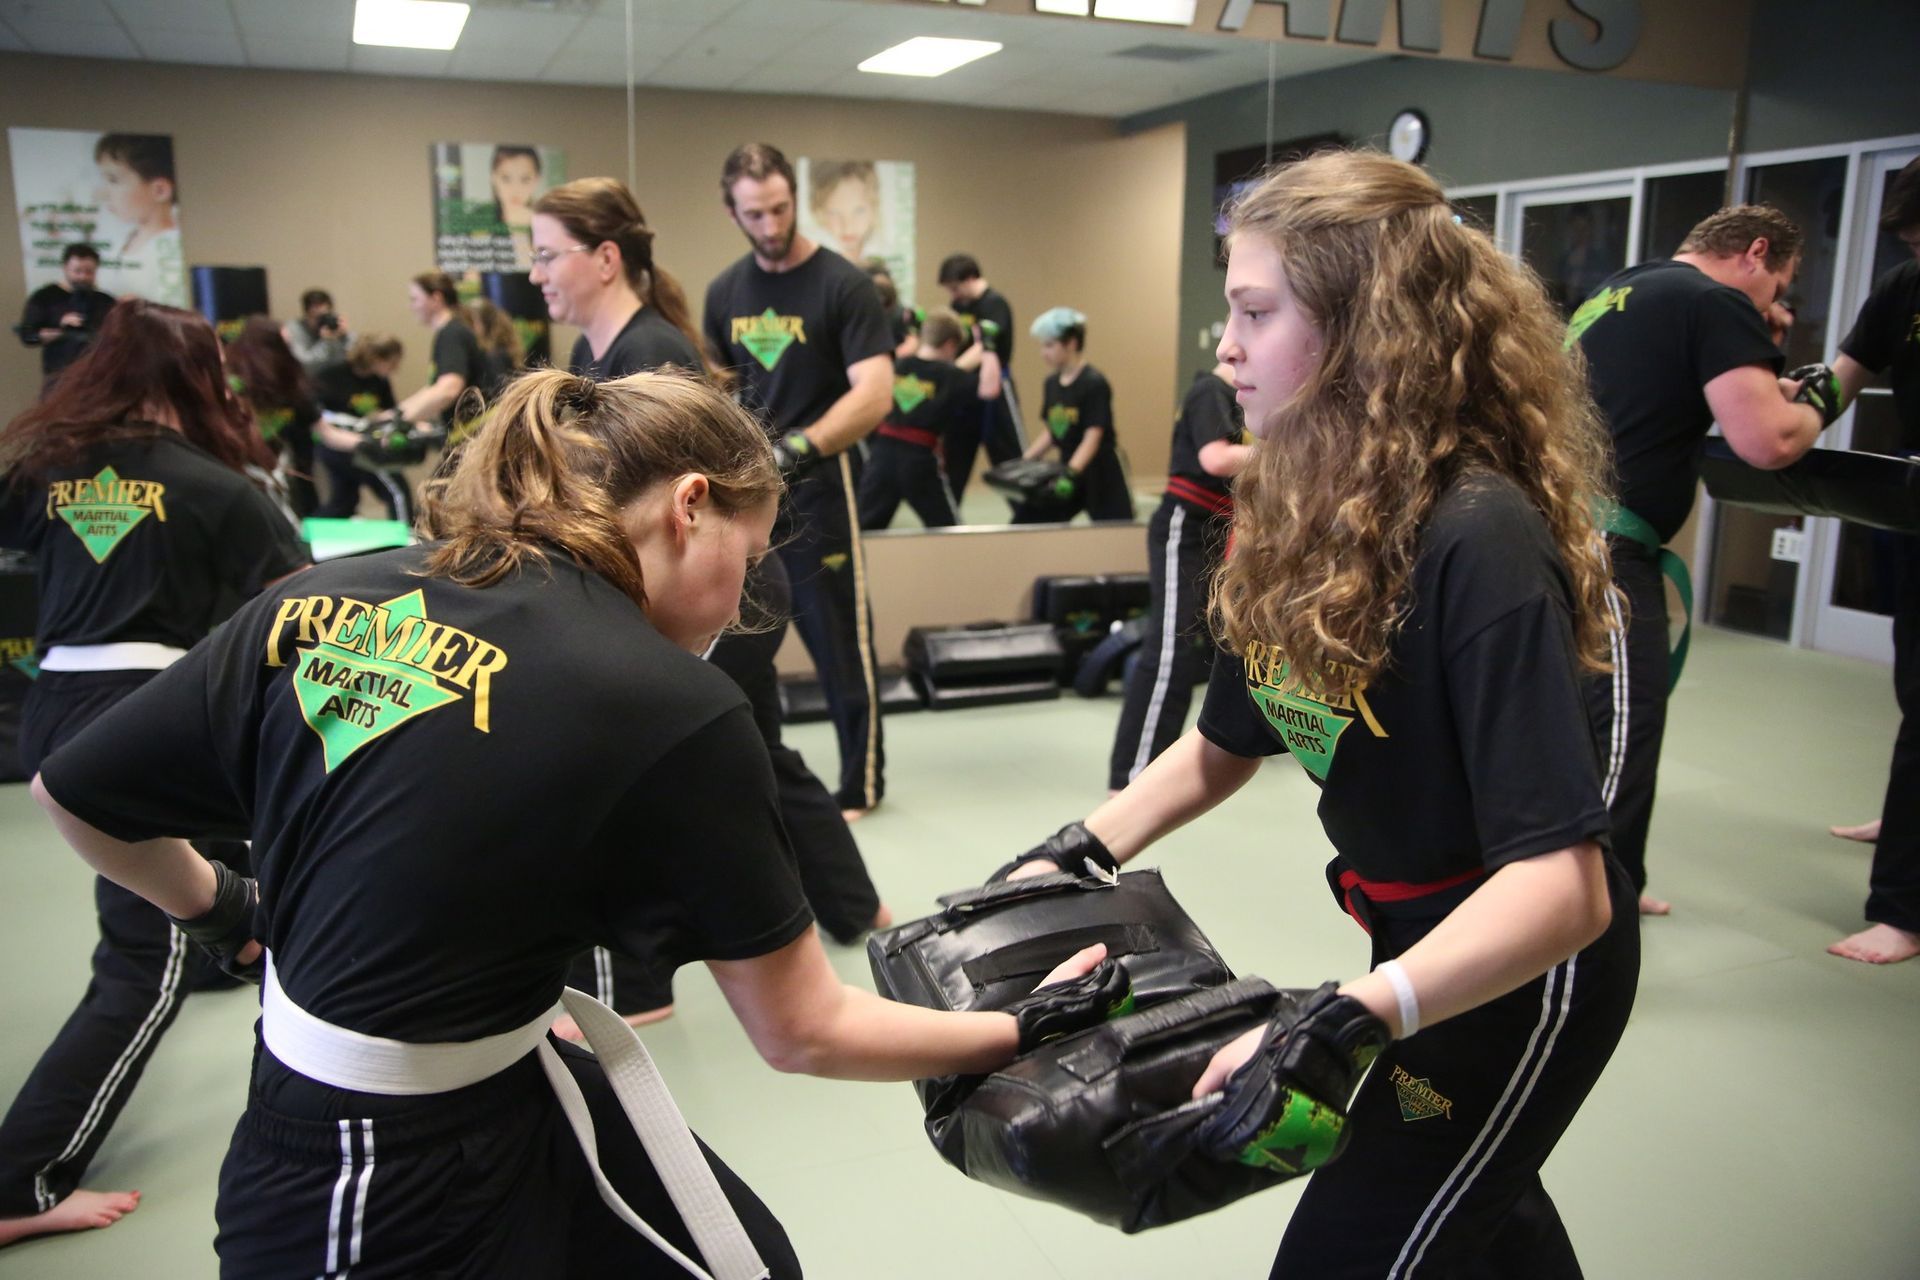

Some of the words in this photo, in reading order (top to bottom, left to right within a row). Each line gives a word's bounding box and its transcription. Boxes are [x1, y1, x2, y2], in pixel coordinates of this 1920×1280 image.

[46, 478, 168, 522] PREMIER
[73, 510, 131, 523] MARTIAL
[86, 525, 117, 537] ARTS
[265, 595, 508, 734] PREMIER
[303, 657, 412, 709] MARTIAL
[317, 695, 381, 729] ARTS
[1265, 698, 1332, 738] MARTIAL
[1287, 728, 1327, 754] ARTS
[1389, 1064, 1453, 1120] PREMIER
